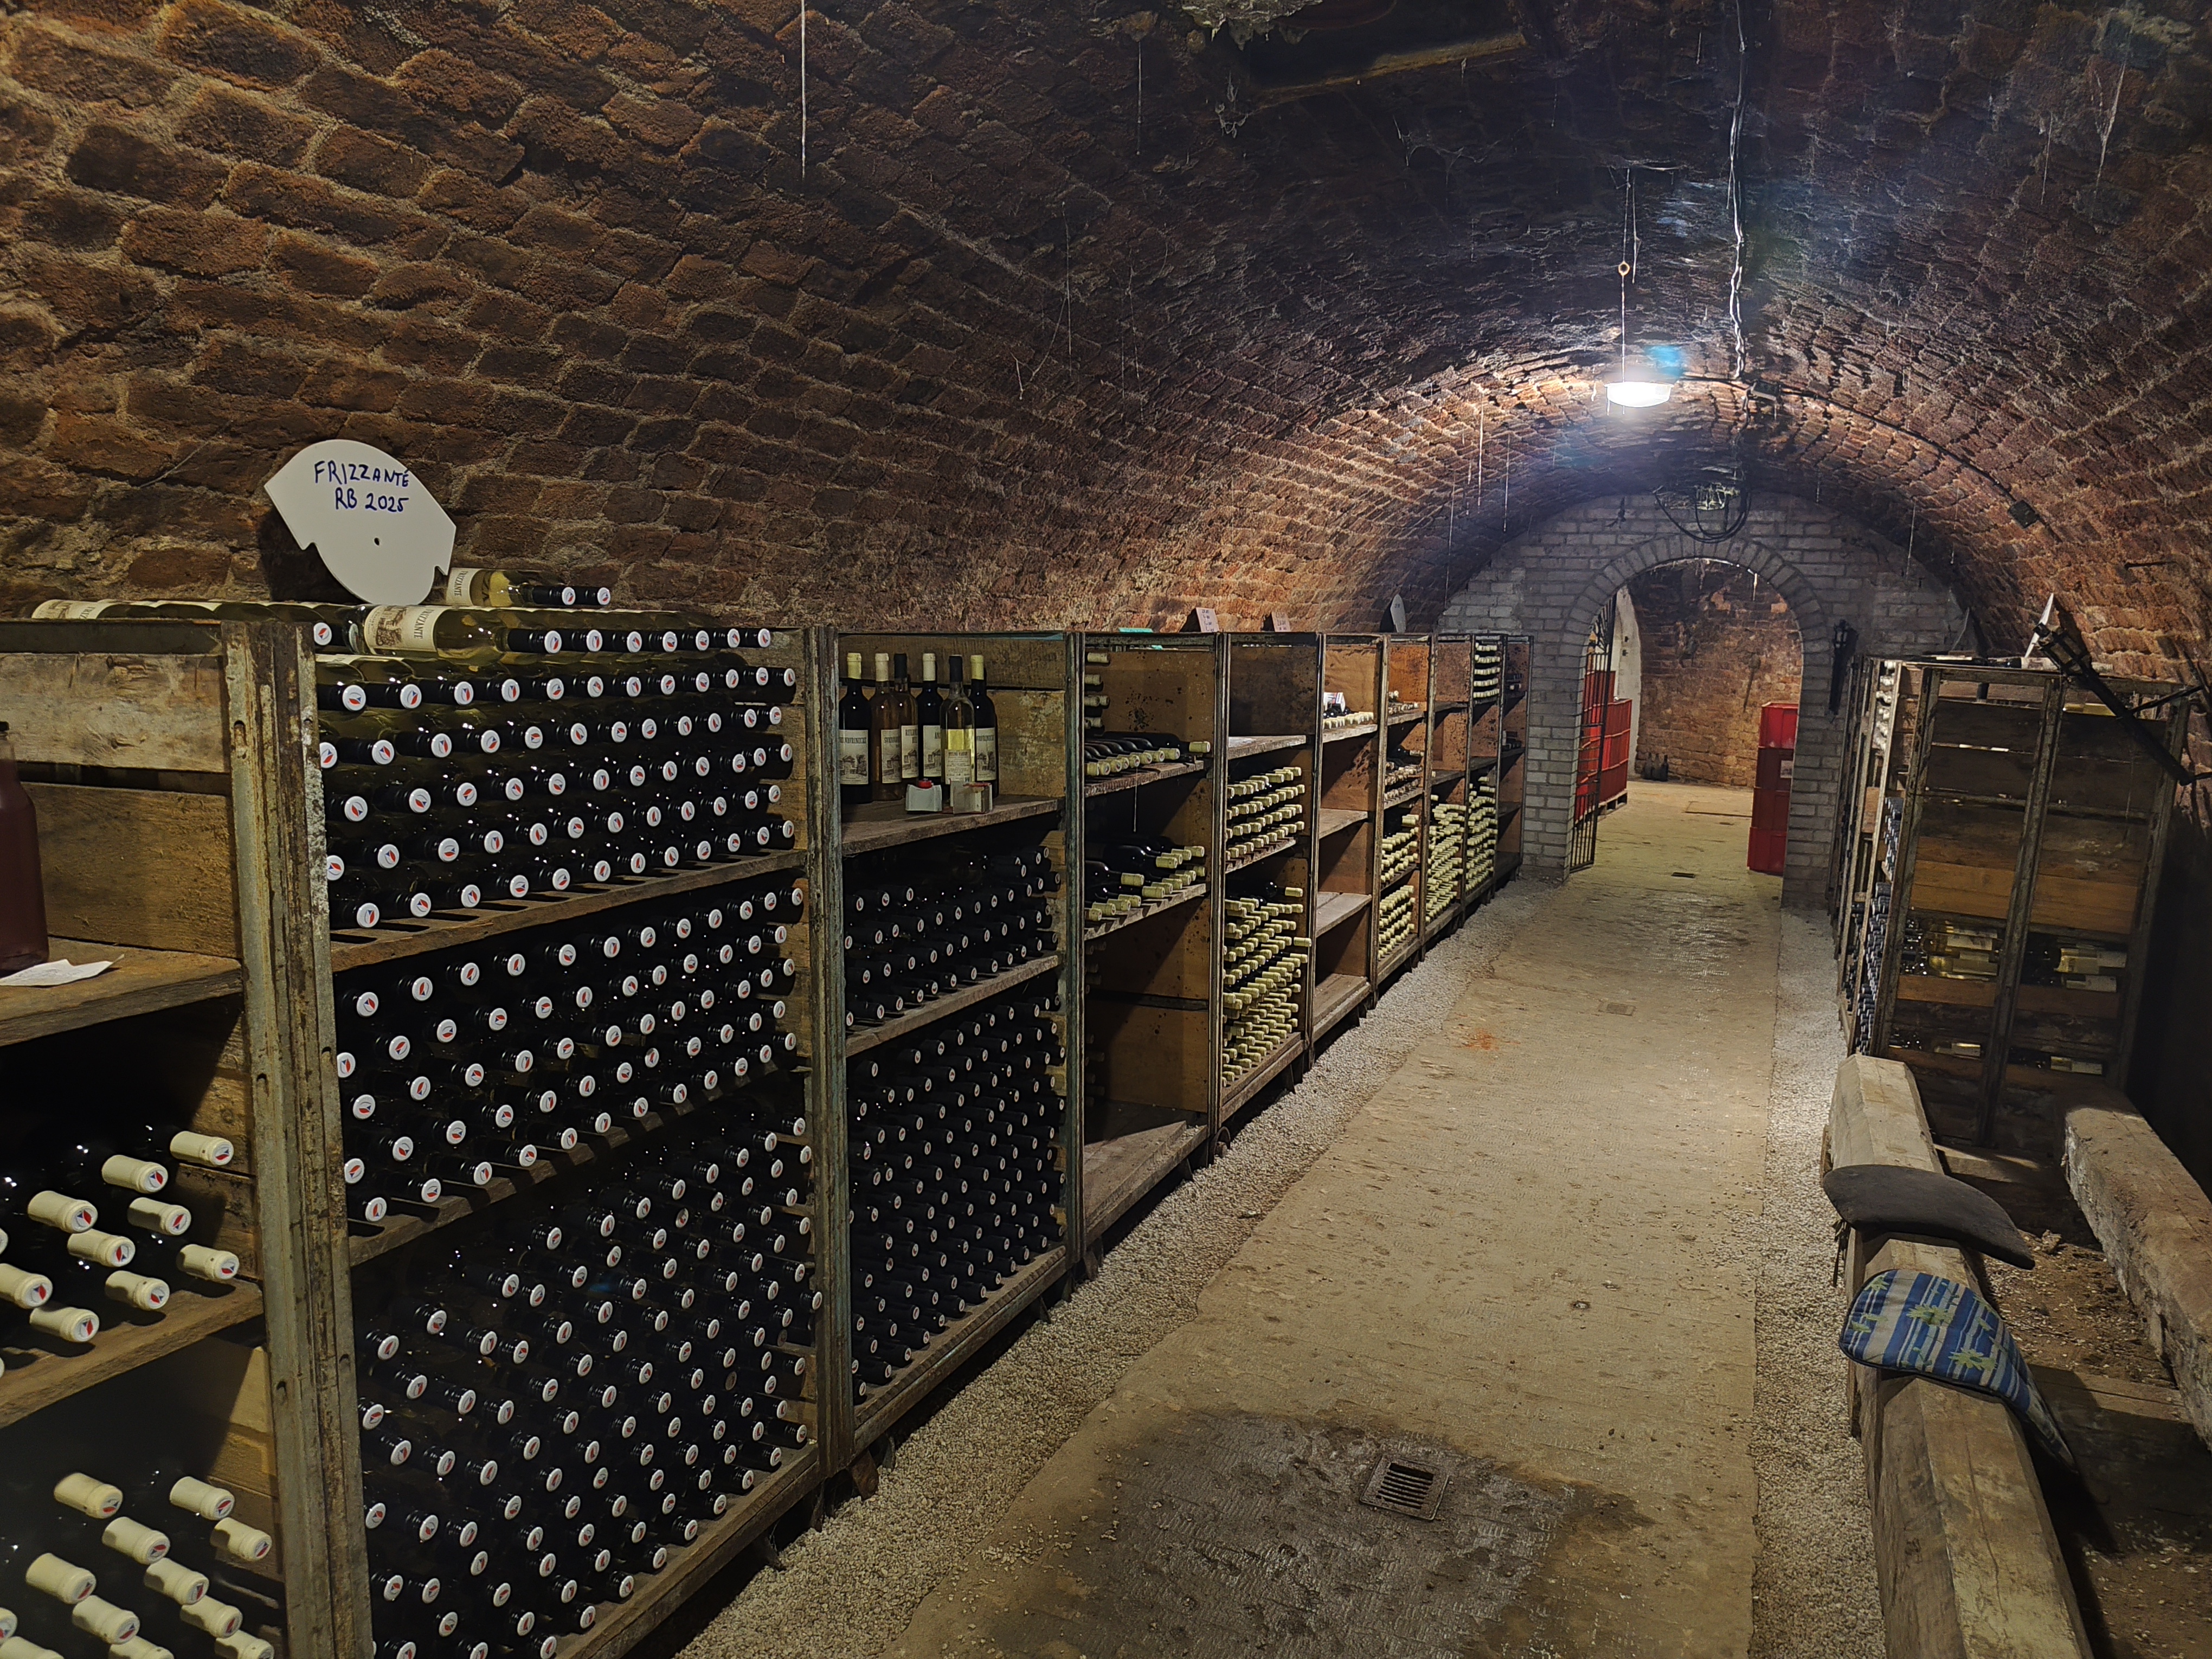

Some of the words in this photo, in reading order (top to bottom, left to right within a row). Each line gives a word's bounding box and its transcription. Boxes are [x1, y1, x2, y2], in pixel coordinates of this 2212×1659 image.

[335, 487, 358, 510] RB
[365, 493, 409, 512] 2025
[454, 570, 468, 596] FRIZZANTE
[414, 609, 434, 639] FRIZZANTE
